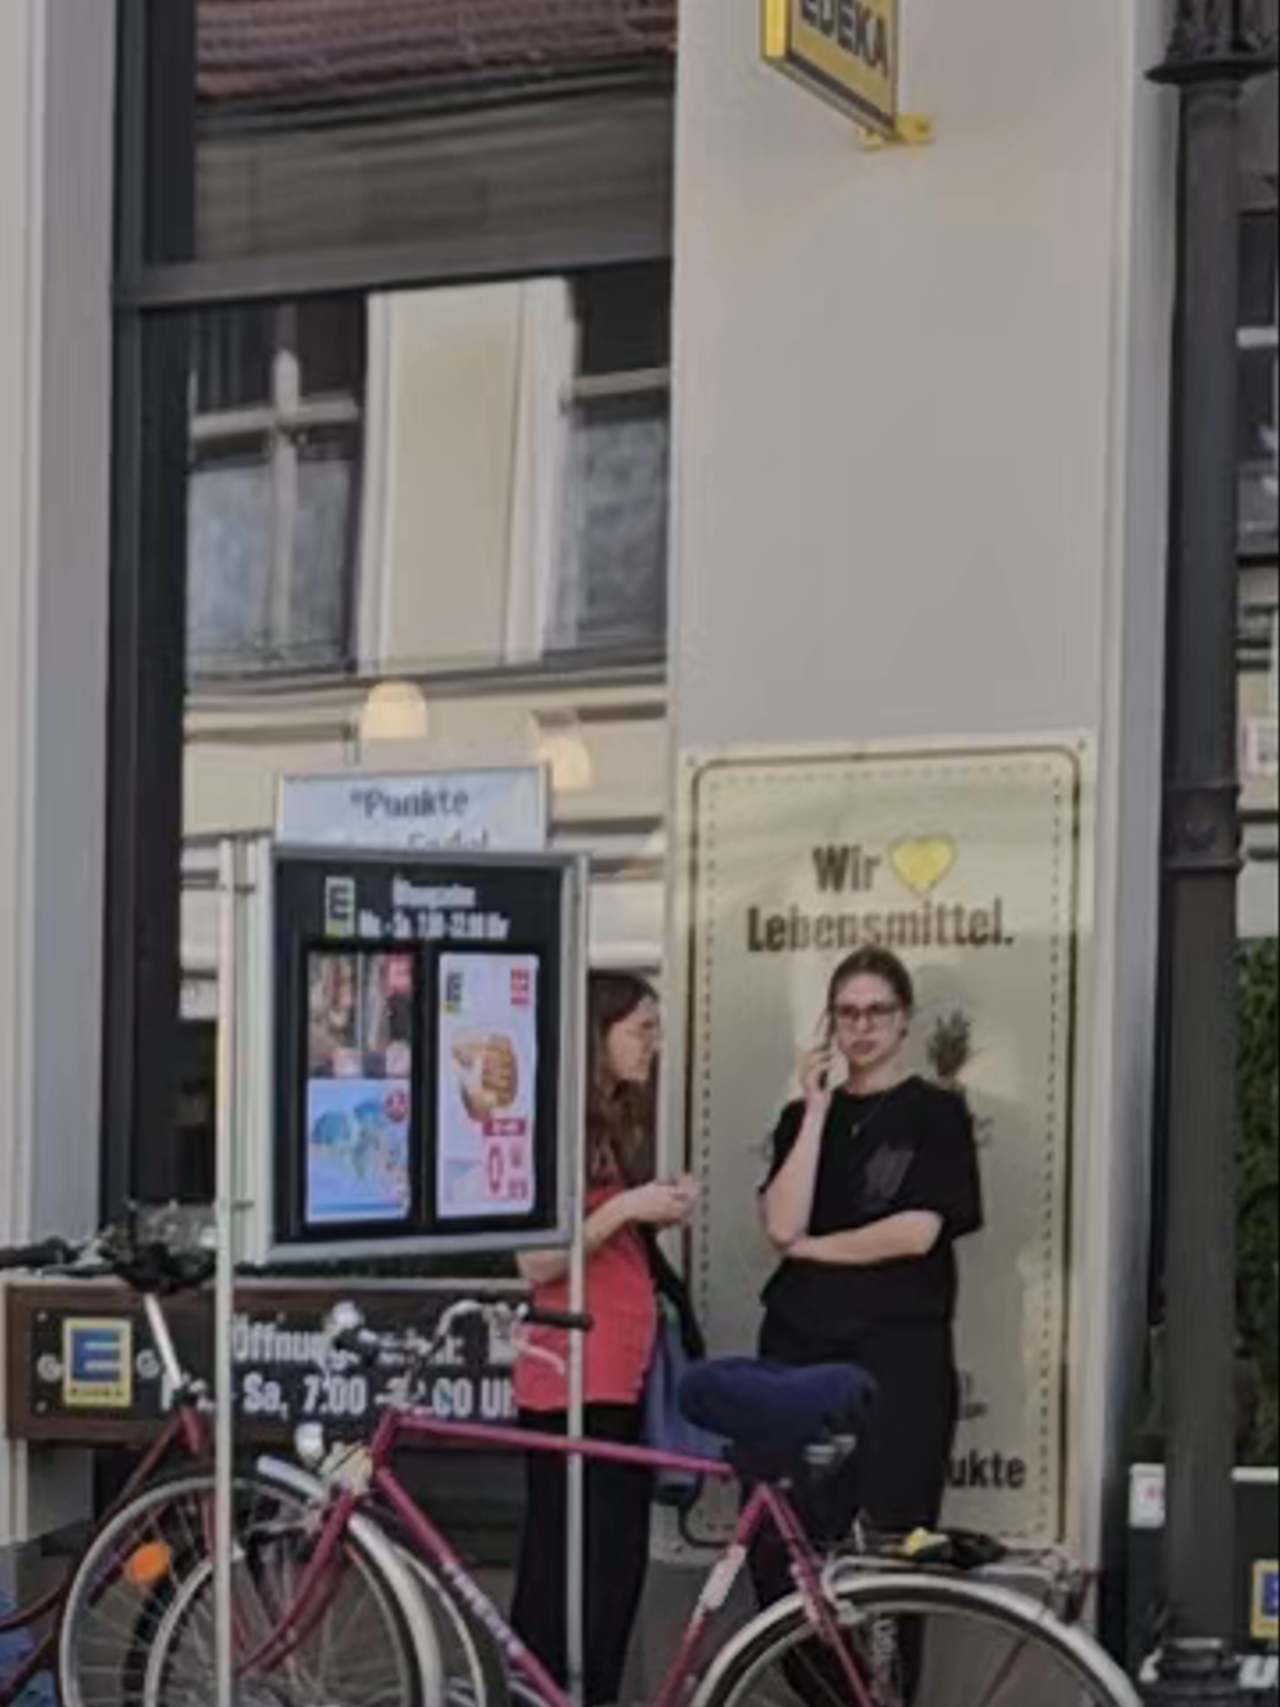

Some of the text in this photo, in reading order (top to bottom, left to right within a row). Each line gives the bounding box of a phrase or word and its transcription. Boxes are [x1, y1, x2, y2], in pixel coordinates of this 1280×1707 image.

[812, 843, 881, 892] Wir
[747, 897, 1014, 953] Lebensmittel.
[946, 1448, 1027, 1490] ukte
